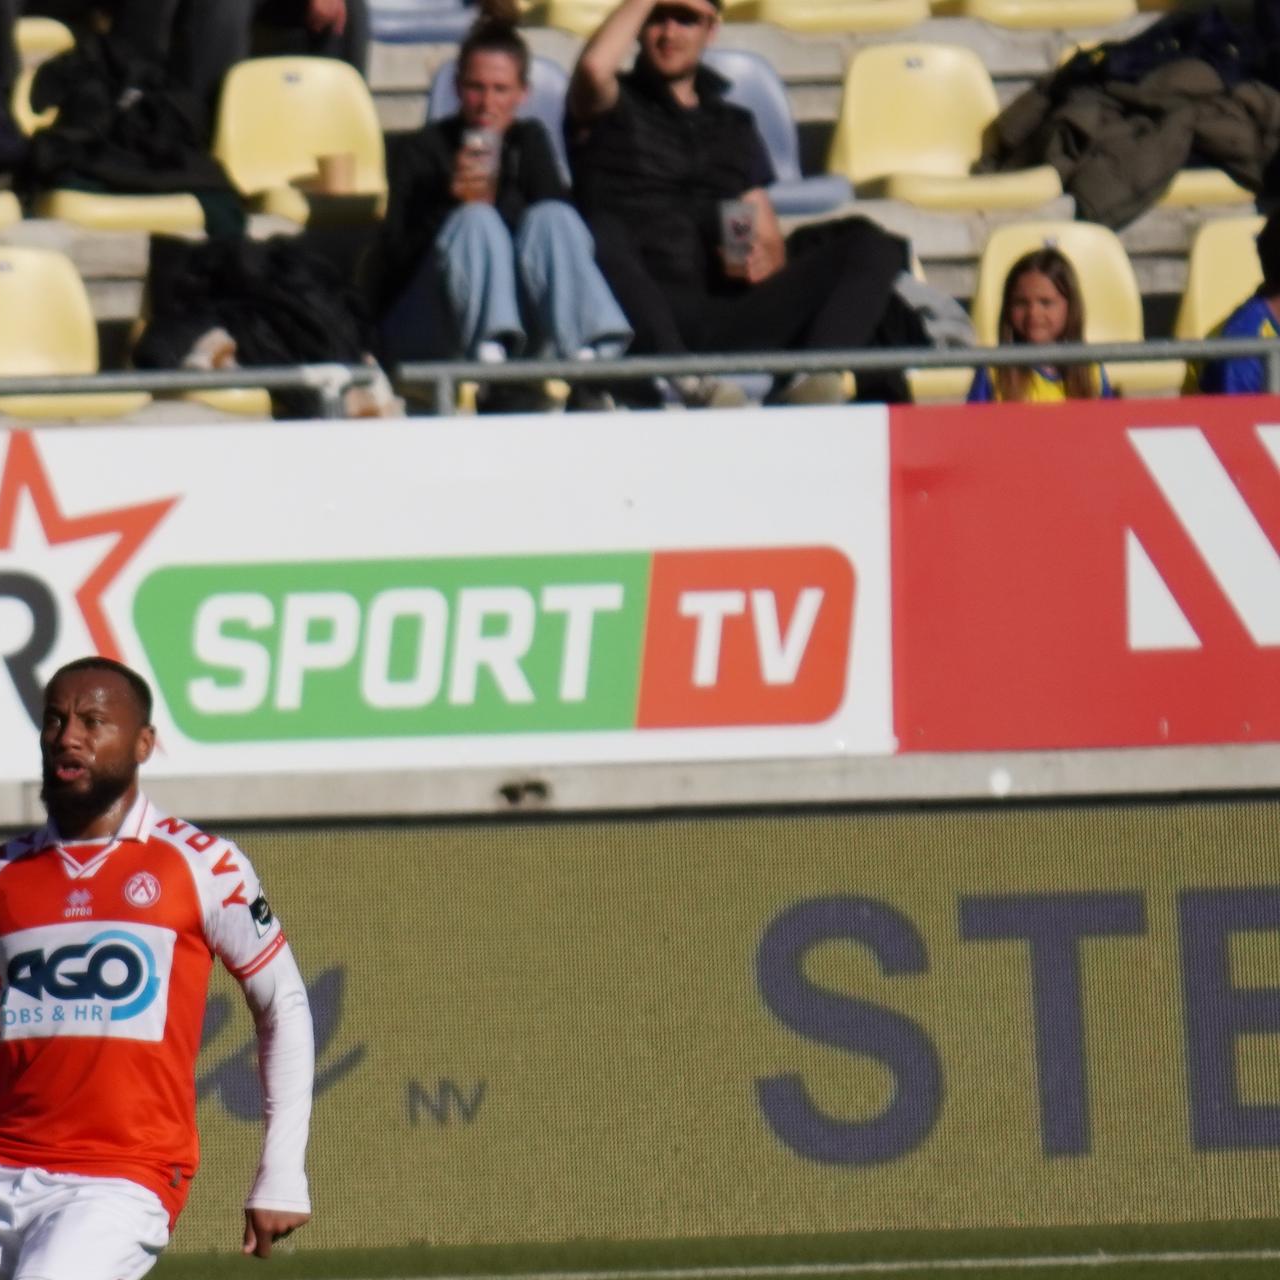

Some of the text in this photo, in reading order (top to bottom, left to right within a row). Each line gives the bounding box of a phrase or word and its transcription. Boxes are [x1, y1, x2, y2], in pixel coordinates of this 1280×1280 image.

[186, 580, 826, 716] SPORT TV
[1, 943, 142, 1004] AGO
[0, 1007, 43, 1026] OBS
[75, 1004, 103, 1021] HR
[405, 1079, 488, 1127] NV
